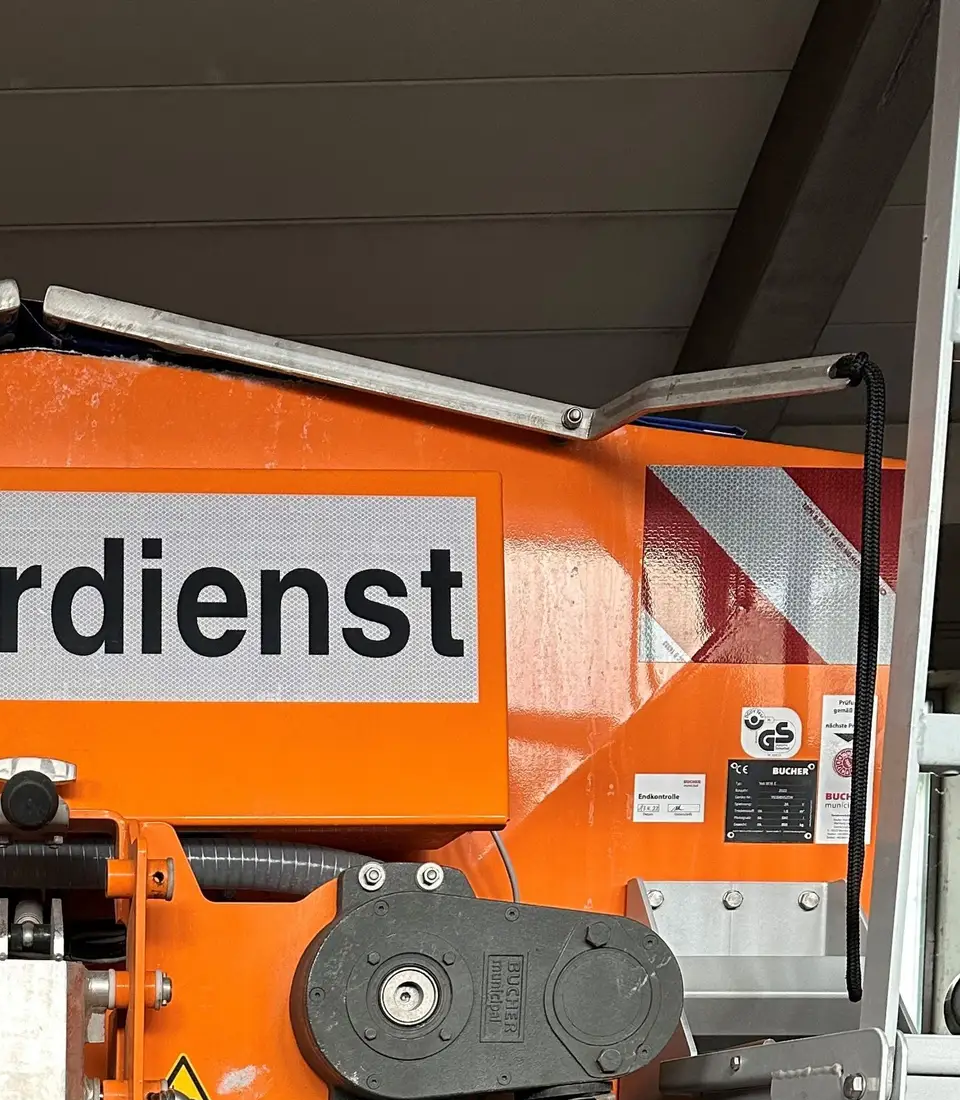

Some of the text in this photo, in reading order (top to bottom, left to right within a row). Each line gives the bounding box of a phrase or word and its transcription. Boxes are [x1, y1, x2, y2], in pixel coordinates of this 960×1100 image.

[758, 721, 794, 751] GS
[772, 767, 809, 775] BUCHER
[825, 793, 852, 801] BUCH
[487, 958, 503, 1033] municipal
[503, 957, 522, 1035] BUCHER
